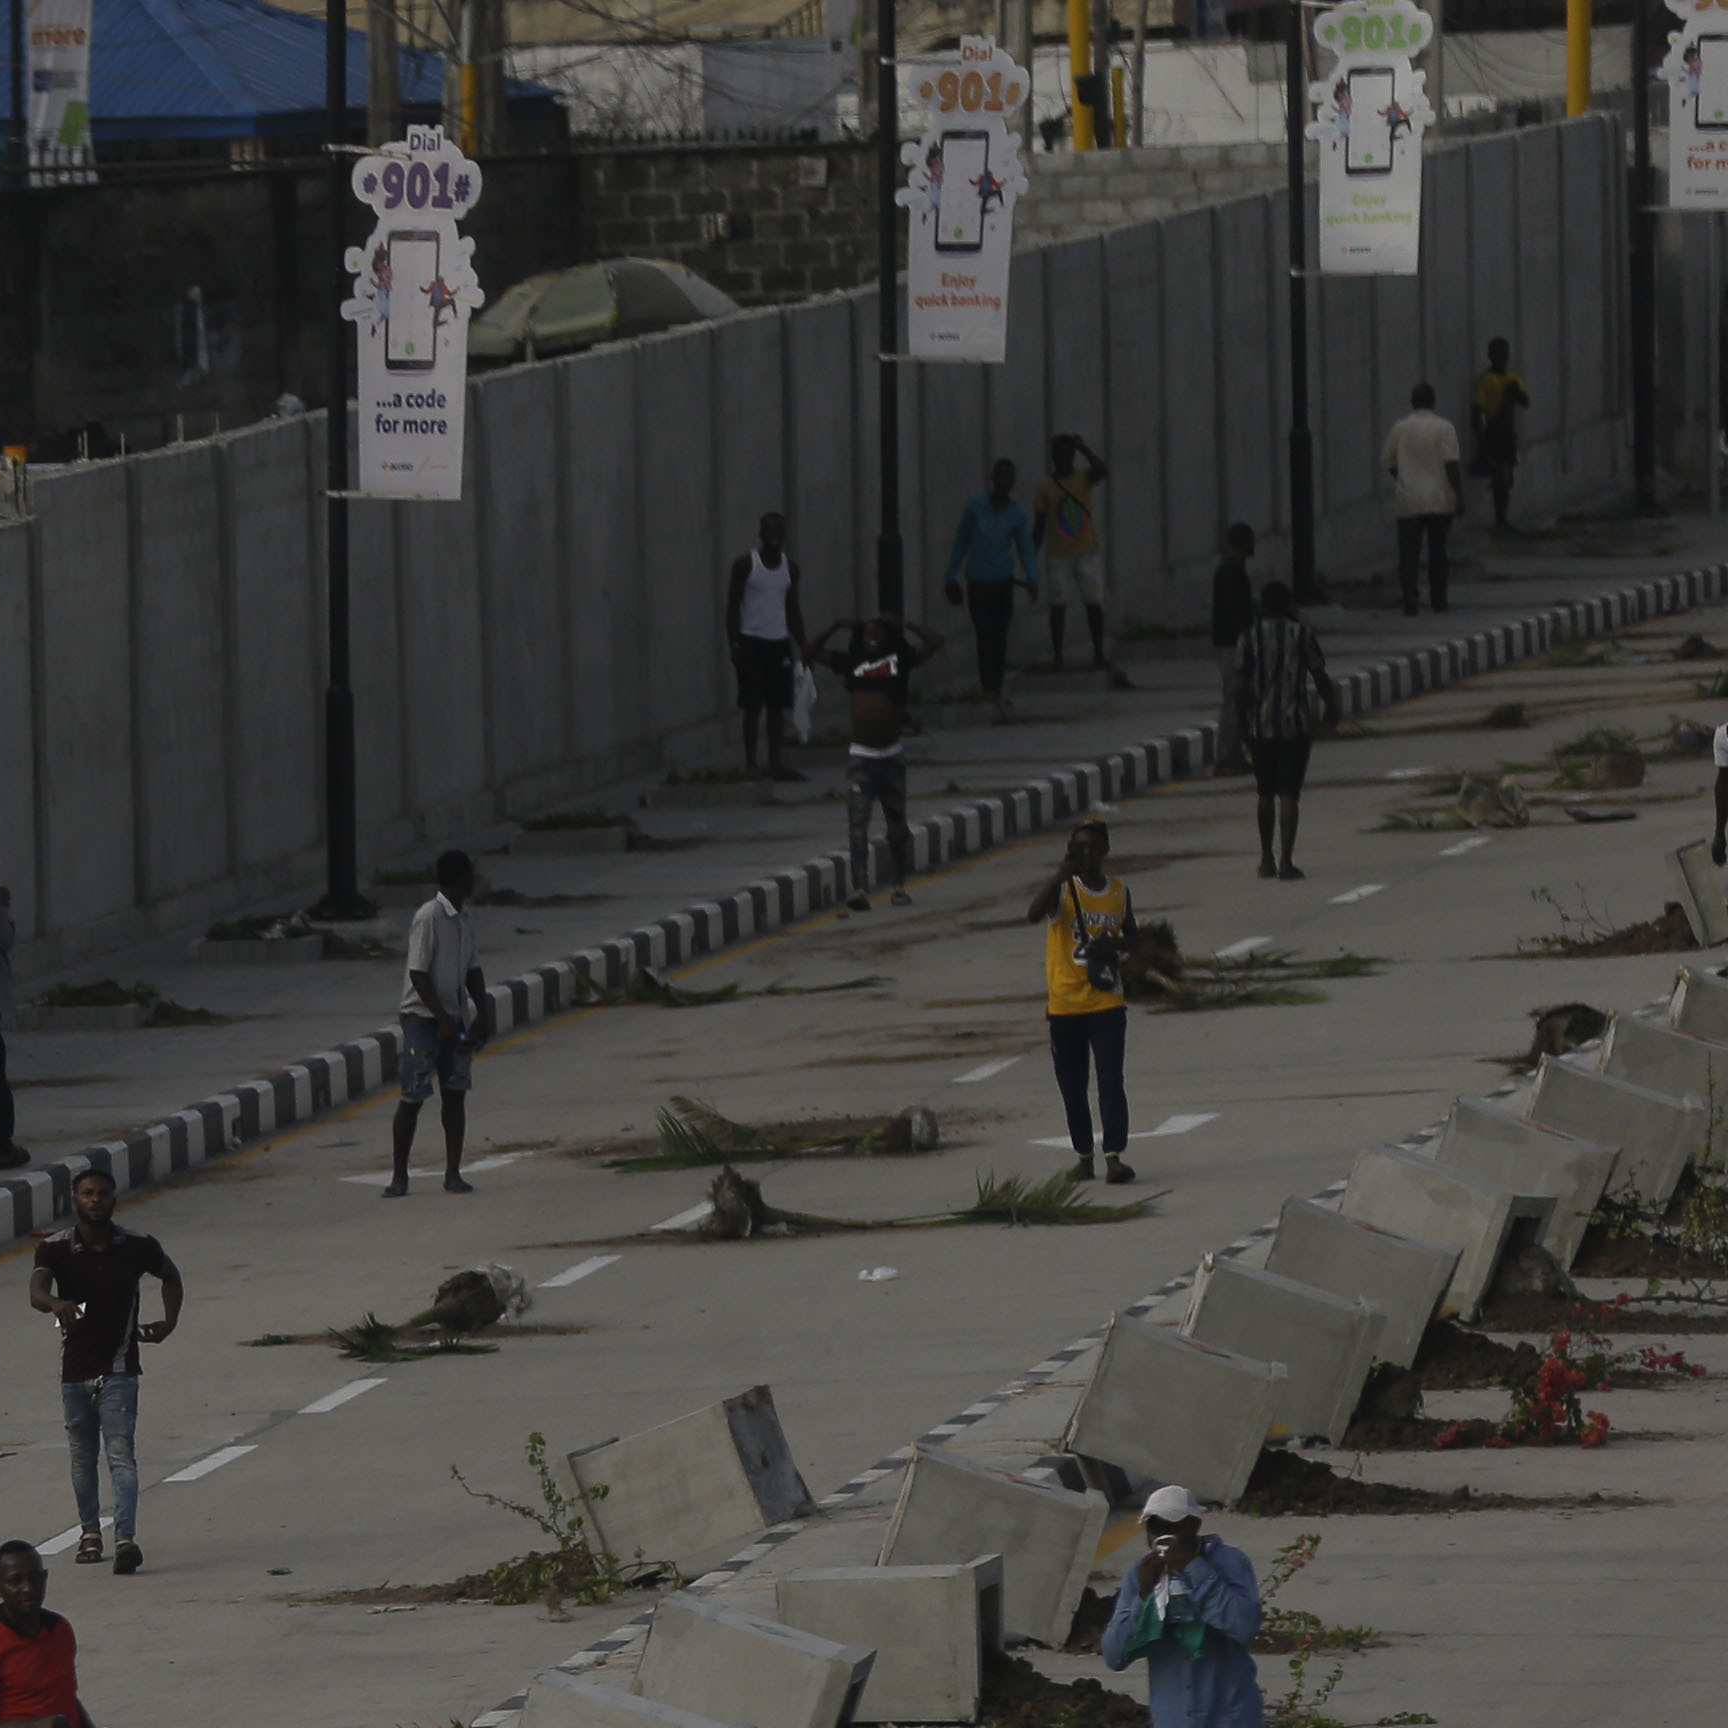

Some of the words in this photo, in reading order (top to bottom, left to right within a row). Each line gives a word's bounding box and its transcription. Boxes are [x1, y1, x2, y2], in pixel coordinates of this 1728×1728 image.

[963, 46, 992, 61] Dial
[410, 134, 440, 151] Dial
[406, 388, 447, 408] code
[375, 413, 399, 433] for
[403, 419, 448, 434] more
